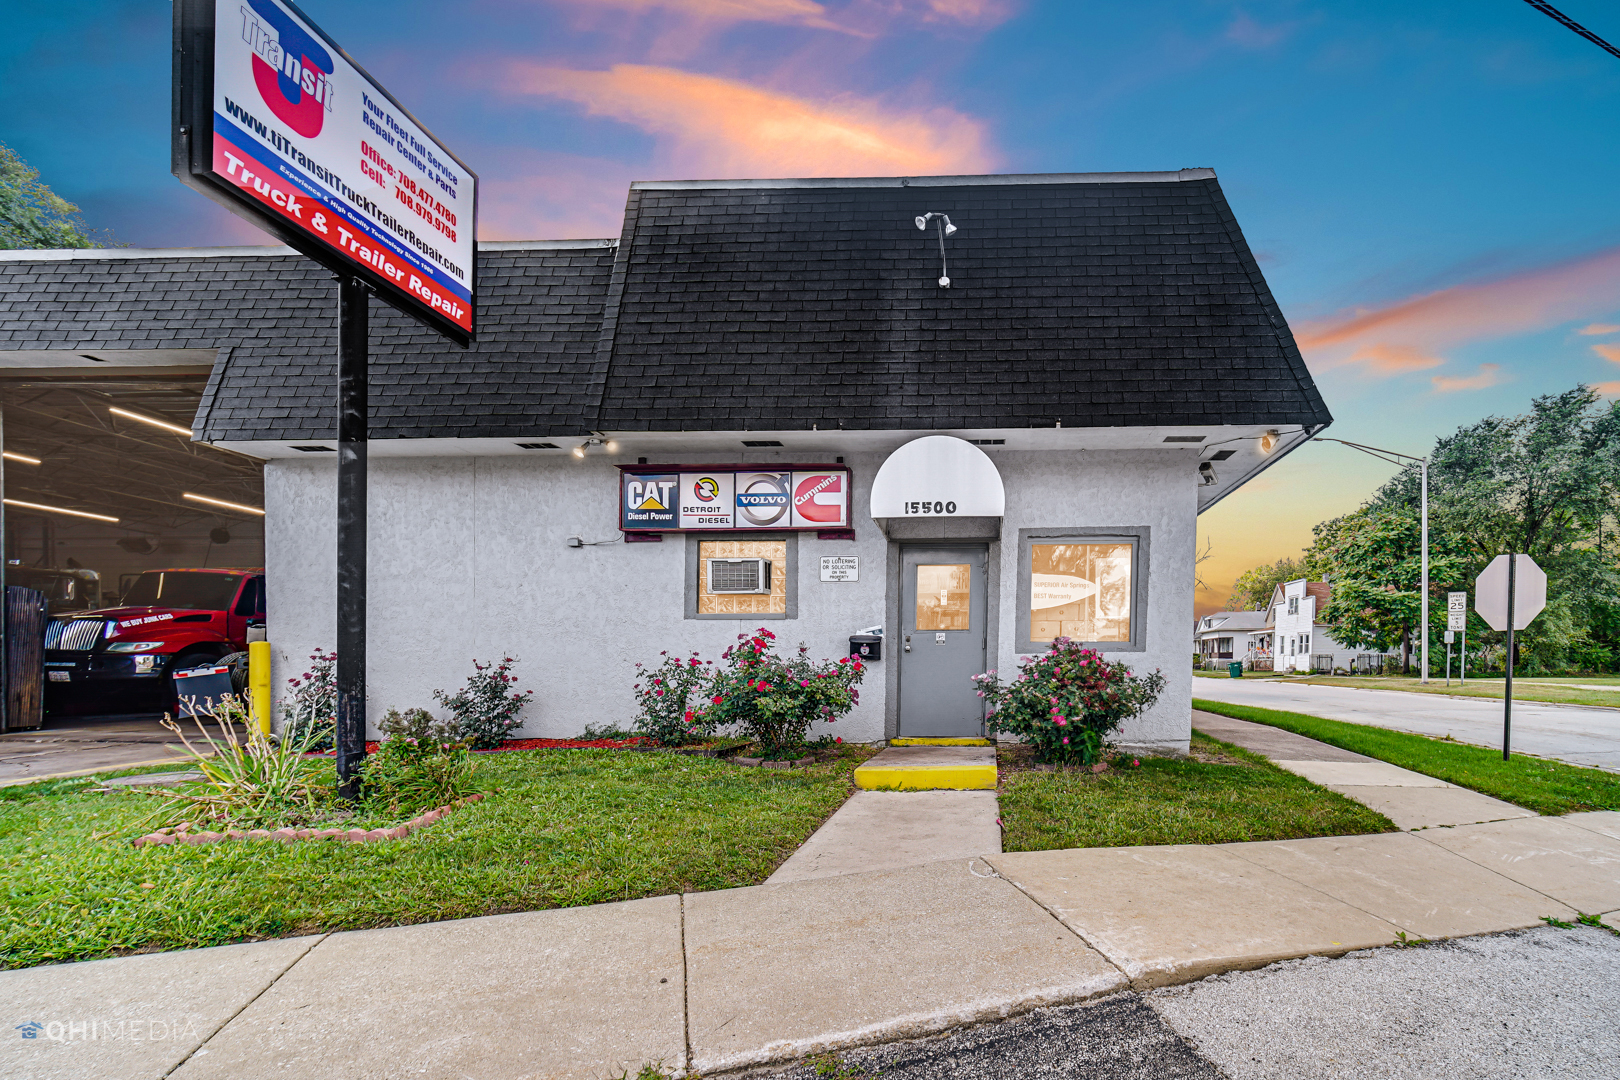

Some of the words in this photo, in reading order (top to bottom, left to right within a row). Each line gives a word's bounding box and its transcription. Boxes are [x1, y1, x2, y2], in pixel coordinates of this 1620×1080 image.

[240, 5, 334, 112] Transit
[362, 91, 384, 120] Your
[386, 113, 409, 143] Fleet
[410, 135, 426, 158] Full
[427, 150, 458, 186] Service
[362, 109, 395, 147] Repair
[396, 140, 427, 174] Center
[427, 168, 434, 182] &
[435, 173, 457, 200] Parts
[224, 95, 465, 281] www.tjTransitTruckTrailerRepair.com
[279, 164, 322, 198] Experience
[323, 195, 329, 203] &
[330, 200, 346, 215] High
[347, 212, 370, 231] Quality
[371, 227, 404, 255] Technology
[404, 251, 420, 265] Since
[360, 159, 386, 190] Cell:
[395, 185, 457, 243] 708.979.9798
[361, 140, 397, 179] Office:
[398, 169, 457, 227] 708.477.4780
[223, 150, 304, 219] Truck
[311, 211, 328, 234] &
[337, 226, 405, 282] Trailer
[408, 274, 464, 320] Repair
[627, 481, 674, 510] CAT
[627, 512, 650, 520] Diesel
[739, 496, 786, 504] VOLVO
[794, 475, 837, 505] Cummins
[904, 501, 957, 514] 15500
[130, 618, 143, 626] BUY
[143, 616, 159, 624] JUNK
